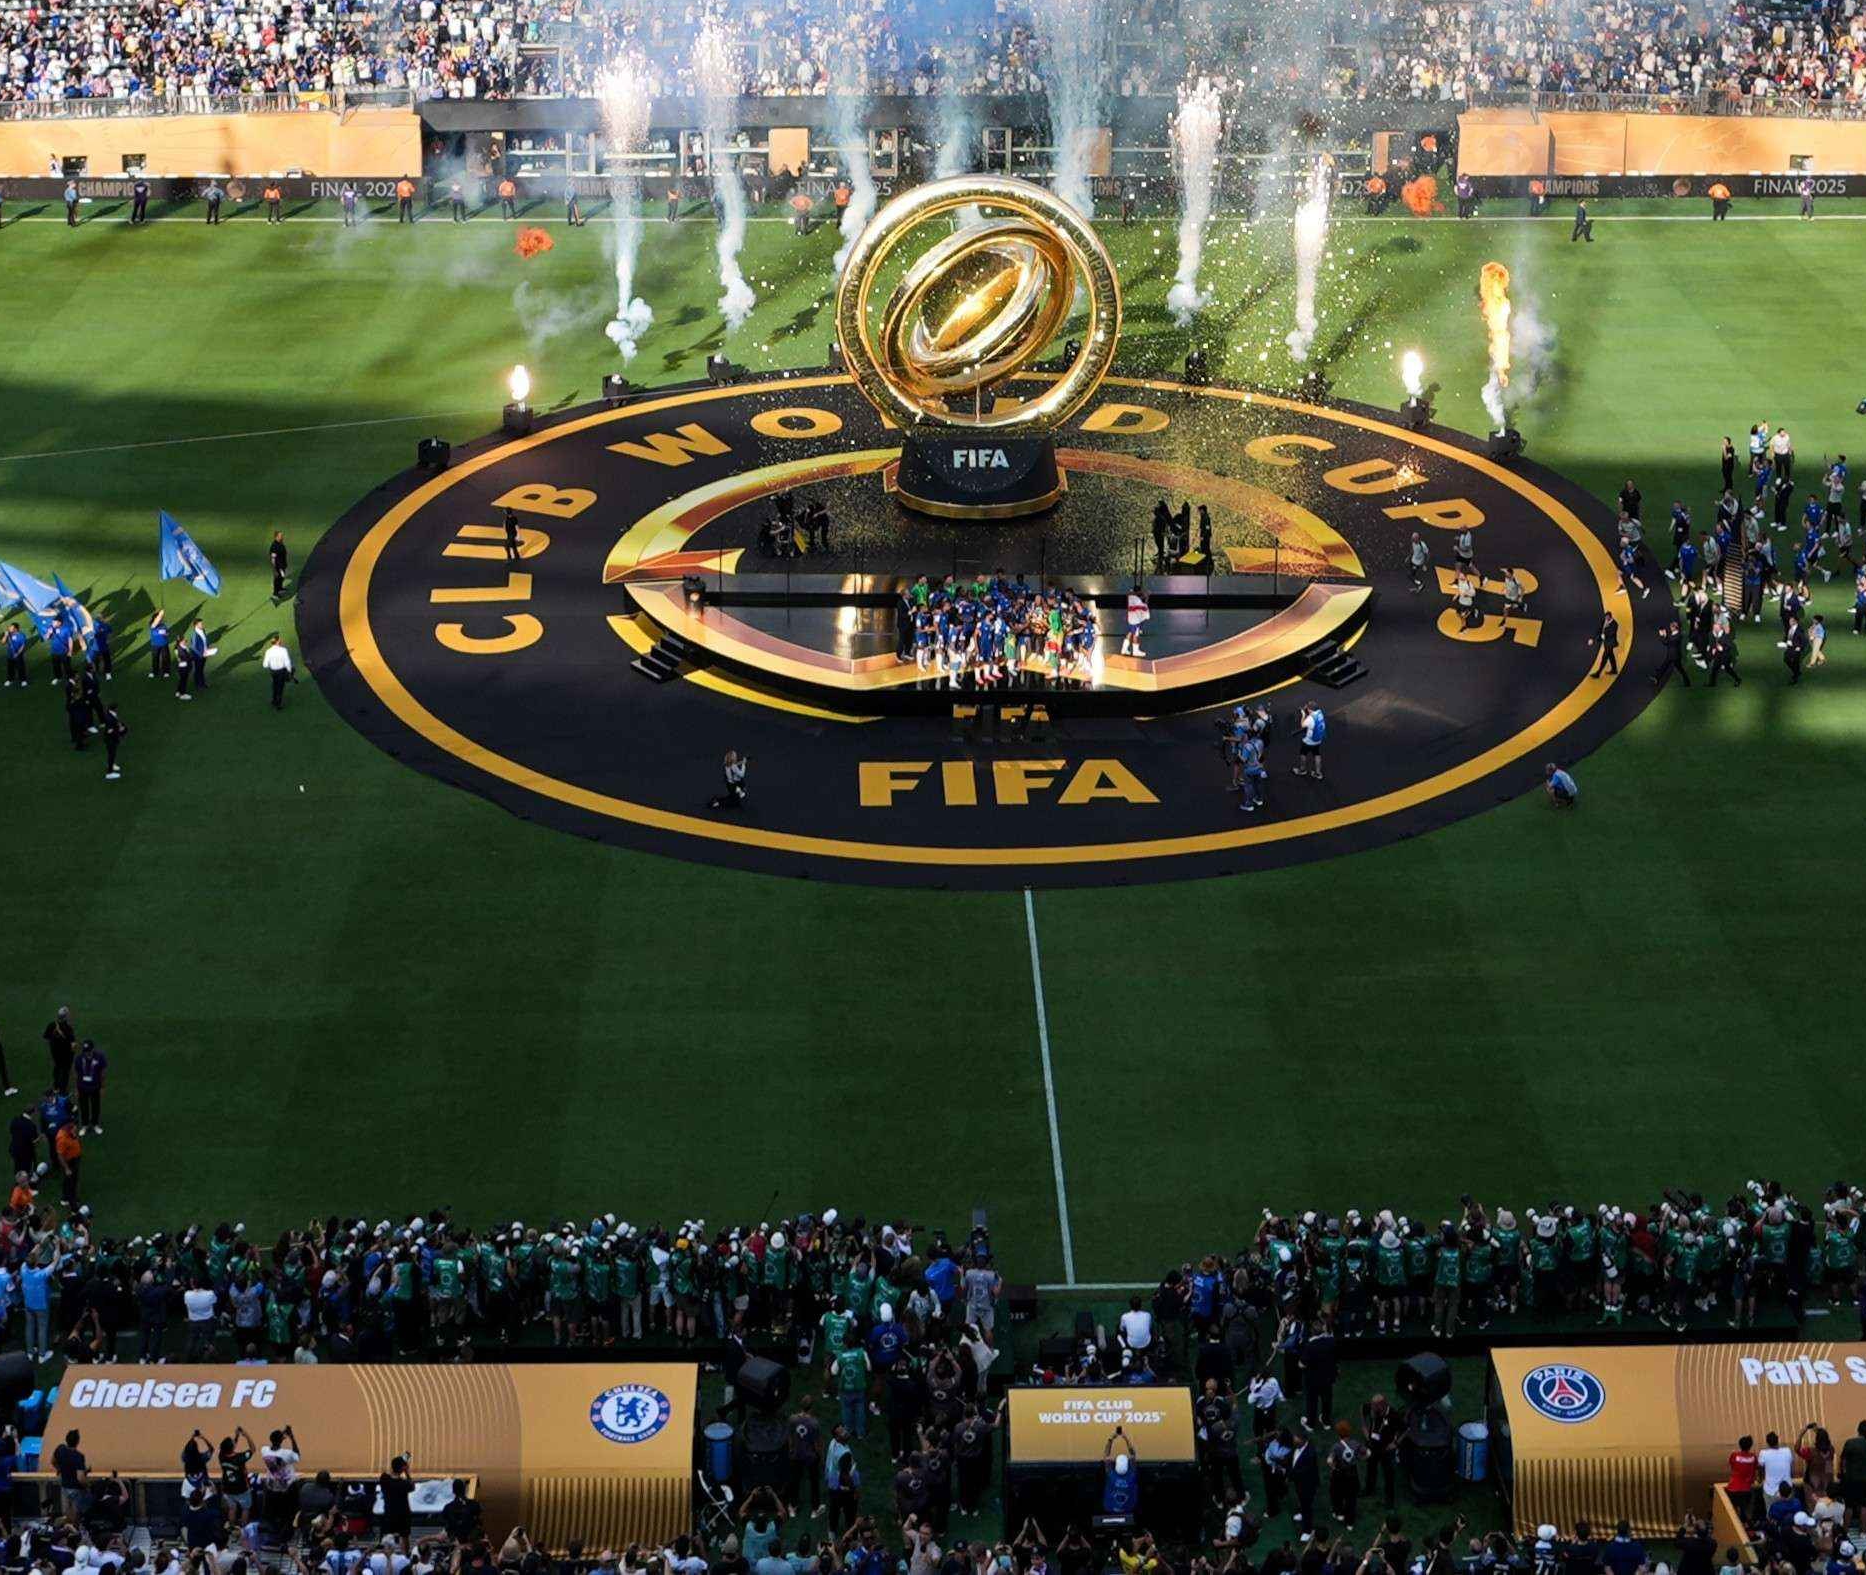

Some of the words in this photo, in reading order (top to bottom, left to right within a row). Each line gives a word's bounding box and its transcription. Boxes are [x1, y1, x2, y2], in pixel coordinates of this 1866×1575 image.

[366, 181, 396, 197] 202
[795, 181, 835, 196] FINA
[952, 448, 1010, 468] FIFA
[429, 481, 598, 654] CLUB
[606, 403, 1170, 467] WOD
[1245, 434, 1486, 530] CUP
[1434, 566, 1544, 648] 25
[858, 759, 1162, 807] FIFA
[1532, 1367, 1585, 1381] PARIS
[1743, 1353, 1840, 1387] Paris
[69, 1378, 222, 1408] Chelsea
[230, 1379, 278, 1408] FC
[1063, 1400, 1094, 1411] FIFA
[1096, 1400, 1133, 1411] CLUB
[1038, 1412, 1090, 1424] WORLD
[1093, 1412, 1122, 1424] CUP
